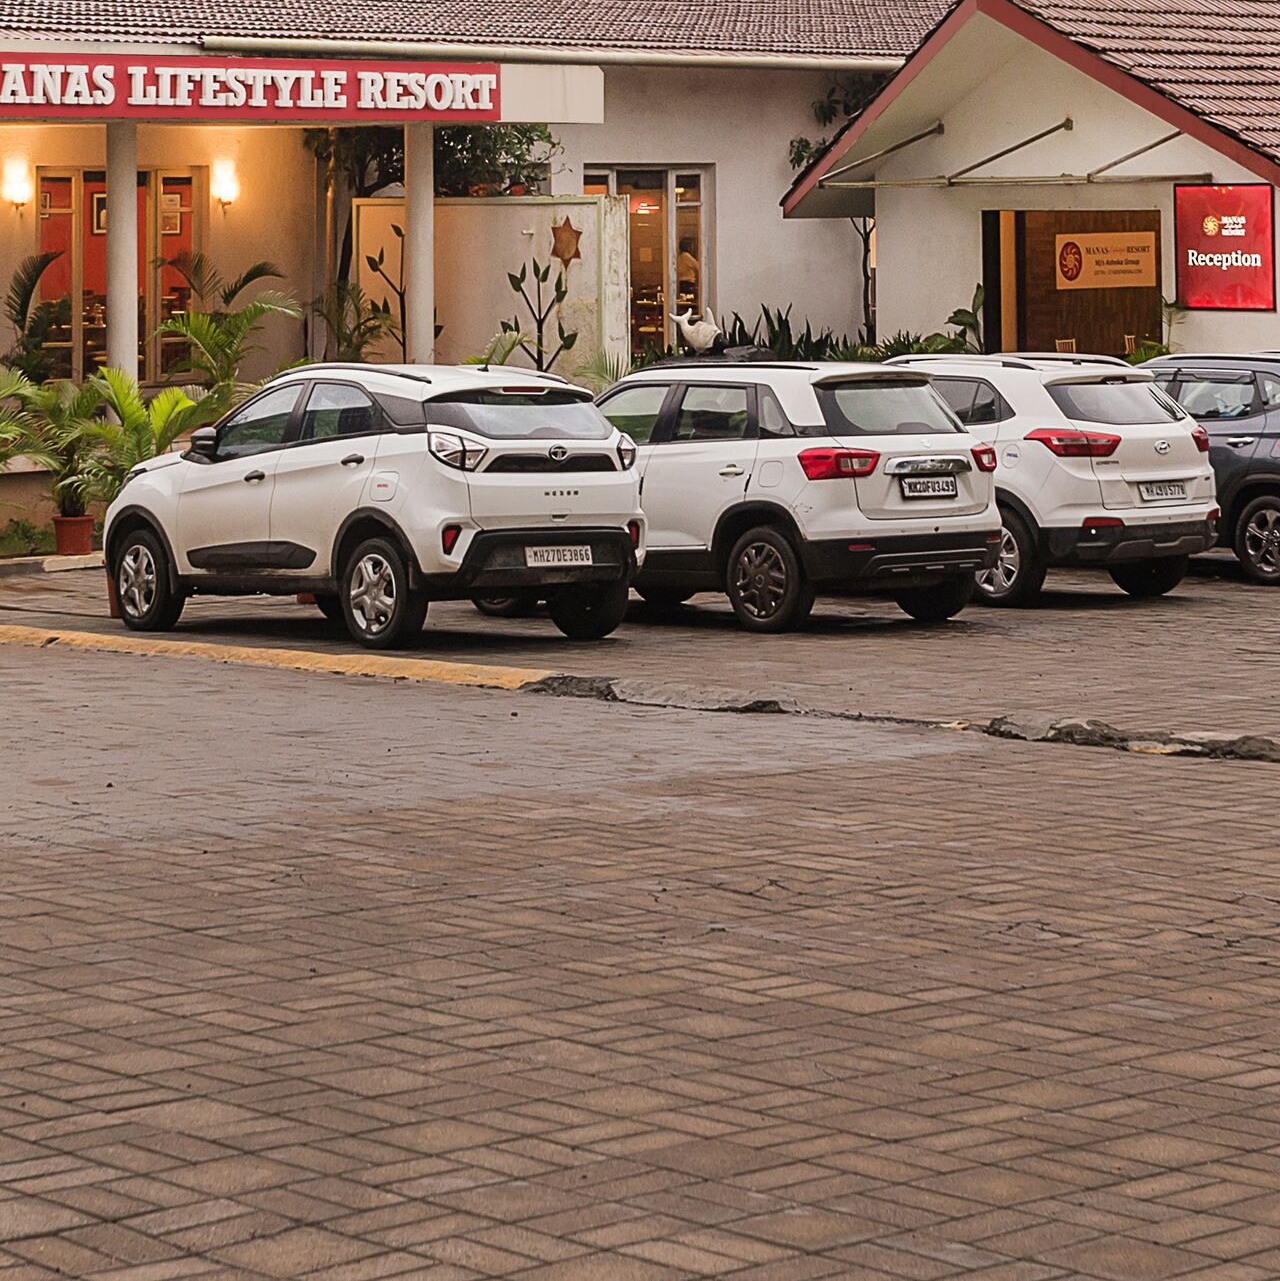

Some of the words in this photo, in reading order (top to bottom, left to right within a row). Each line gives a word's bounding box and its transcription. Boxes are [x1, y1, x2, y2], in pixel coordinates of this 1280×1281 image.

[127, 66, 347, 109] LIFESTYLE
[356, 70, 497, 111] RESORT
[1085, 246, 1110, 255] MANAS
[1126, 245, 1151, 254] RESORT
[1187, 249, 1262, 270] Reception
[532, 548, 590, 563] MH27DE3866
